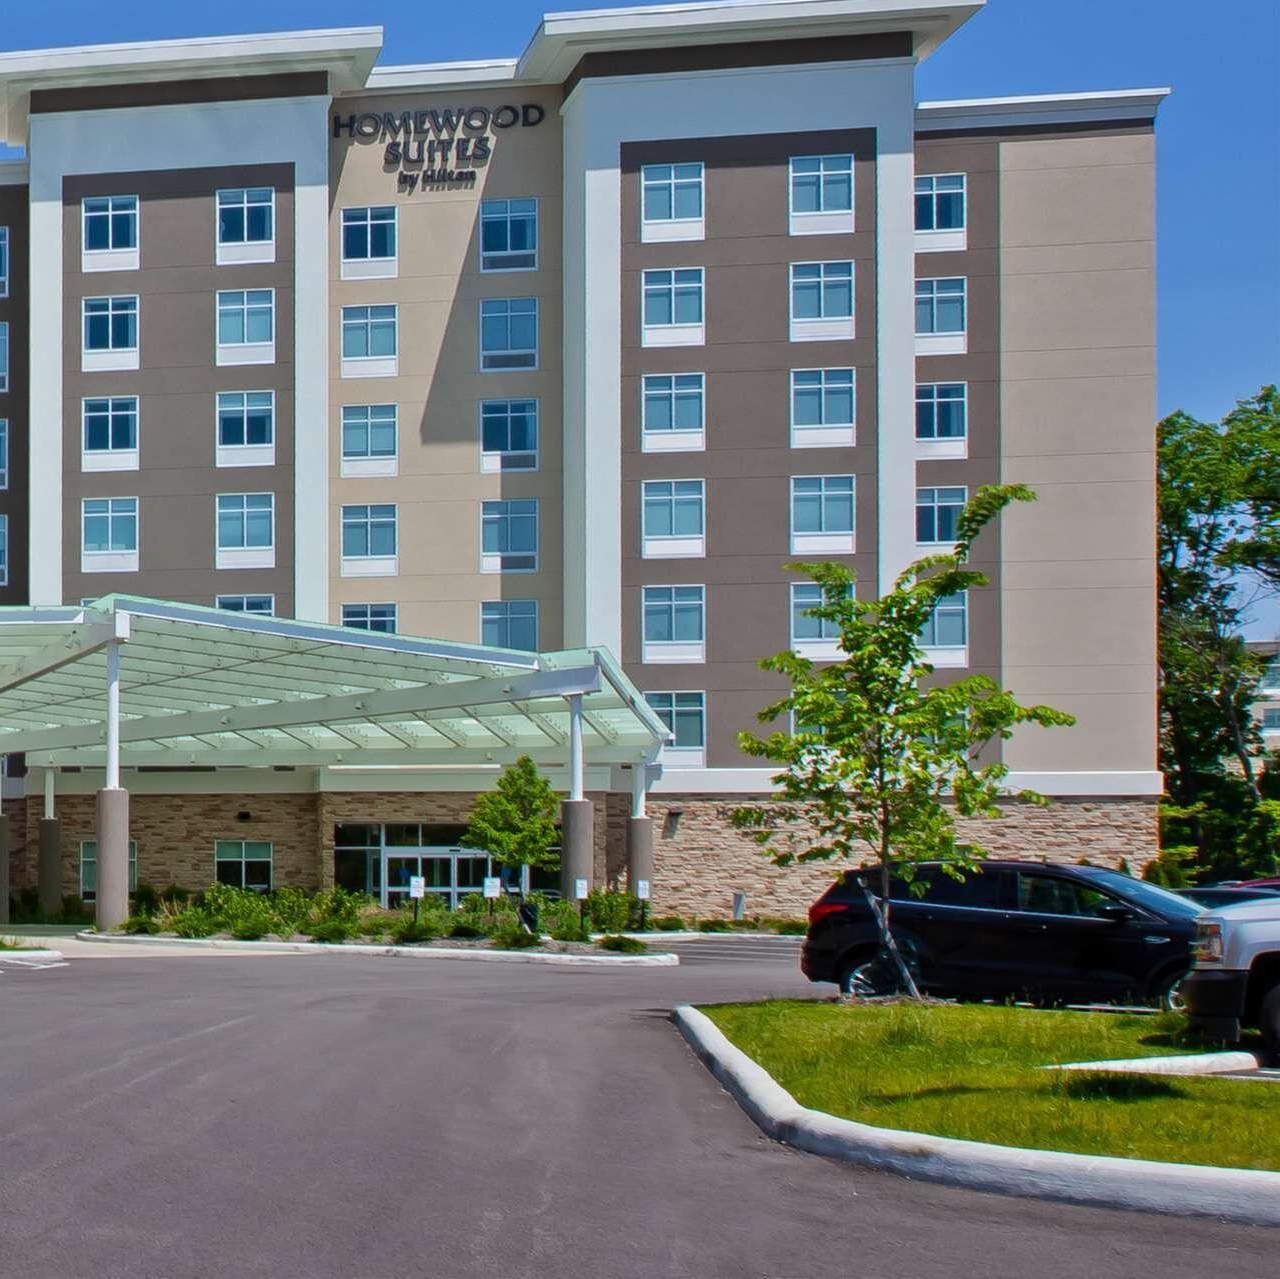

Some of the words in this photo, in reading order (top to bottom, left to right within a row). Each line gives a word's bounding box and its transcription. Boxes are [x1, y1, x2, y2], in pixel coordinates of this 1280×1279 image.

[333, 104, 545, 139] HOMEWOOD
[384, 137, 491, 163] SUITES
[398, 170, 419, 188] by
[422, 170, 477, 184] Hilton
